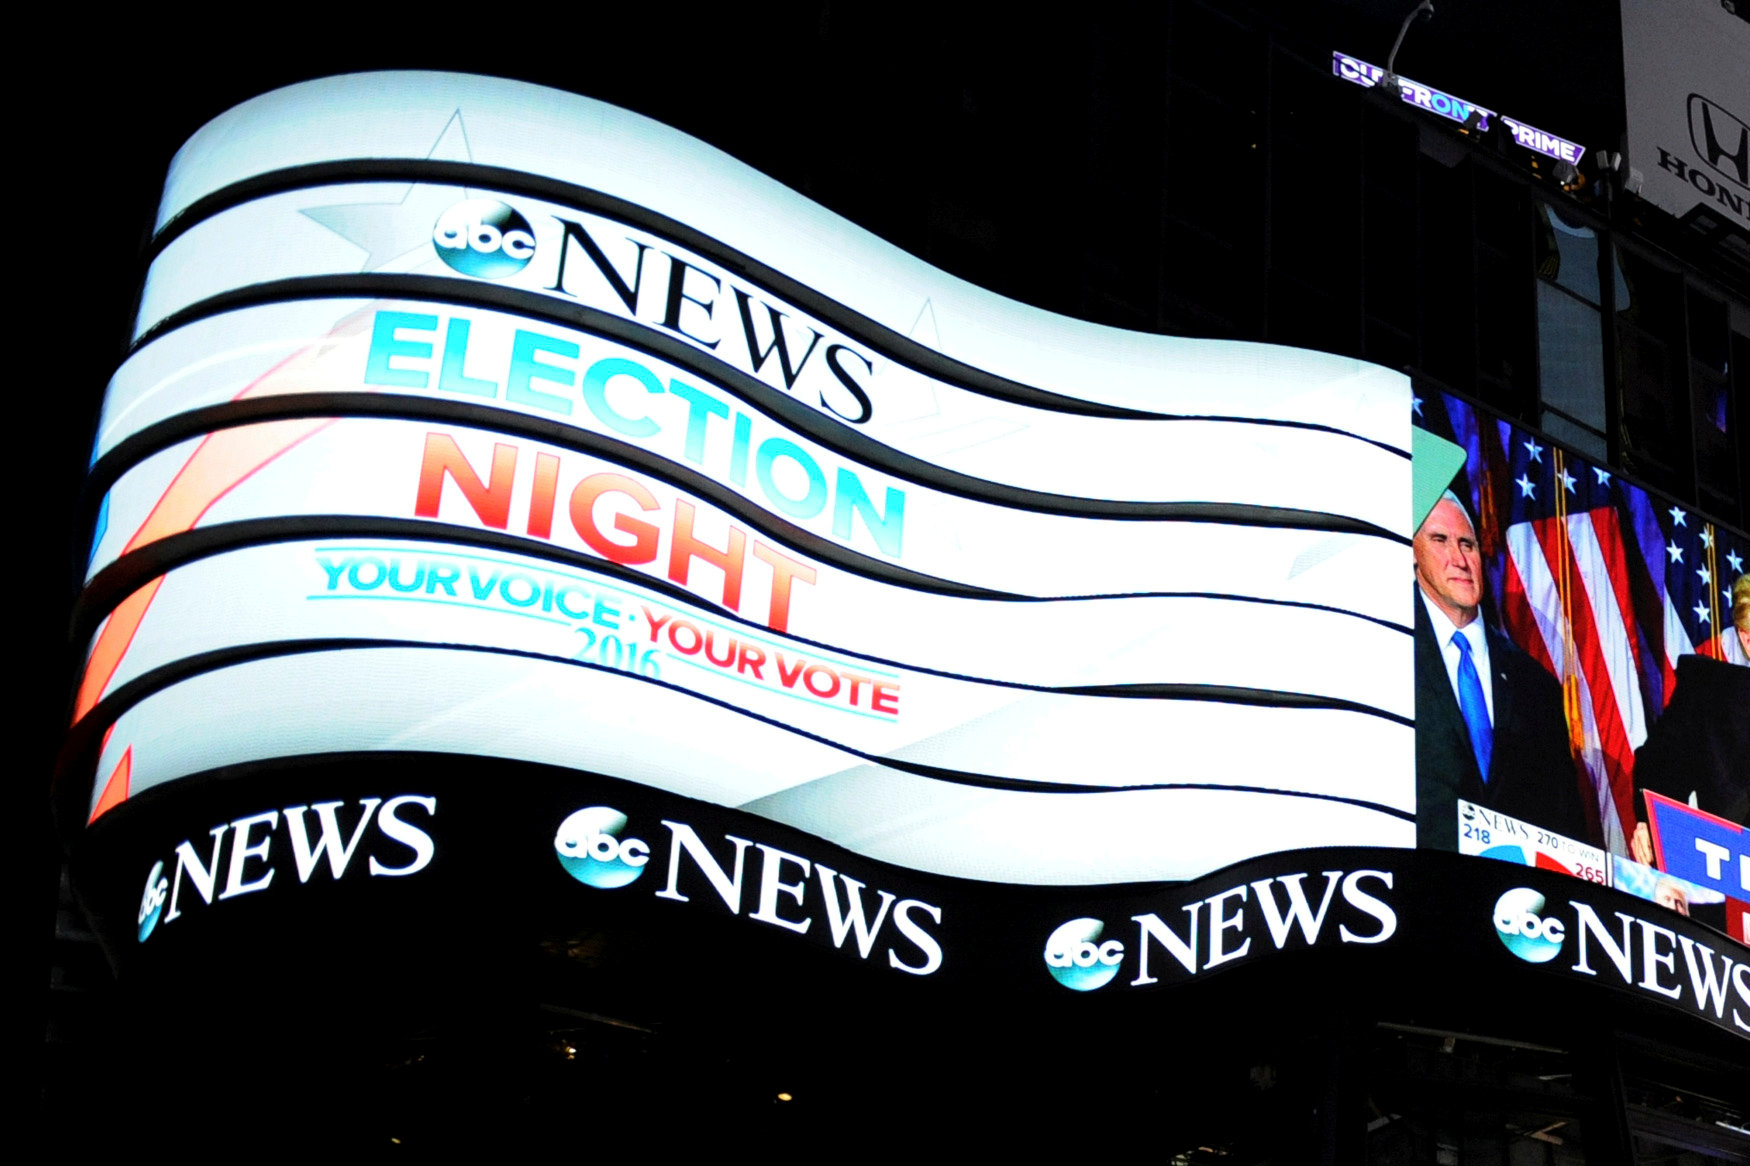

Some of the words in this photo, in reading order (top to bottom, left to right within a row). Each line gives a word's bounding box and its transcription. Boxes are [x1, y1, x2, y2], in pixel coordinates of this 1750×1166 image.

[433, 213, 536, 262] abc
[543, 214, 874, 425] NEWS
[363, 309, 907, 559] ELECTION
[414, 431, 817, 633] NIGHT
[315, 556, 461, 597] YOUR
[467, 564, 622, 630] VOICE
[640, 604, 767, 680] YOUR
[775, 652, 901, 716] VOTE
[573, 627, 662, 682] 2016
[164, 794, 437, 924] NEWS
[655, 819, 943, 975] NEWS
[1463, 823, 1491, 844] 218
[1538, 831, 1559, 849] 270
[1575, 862, 1605, 885] 265
[1130, 869, 1398, 988] NEWS
